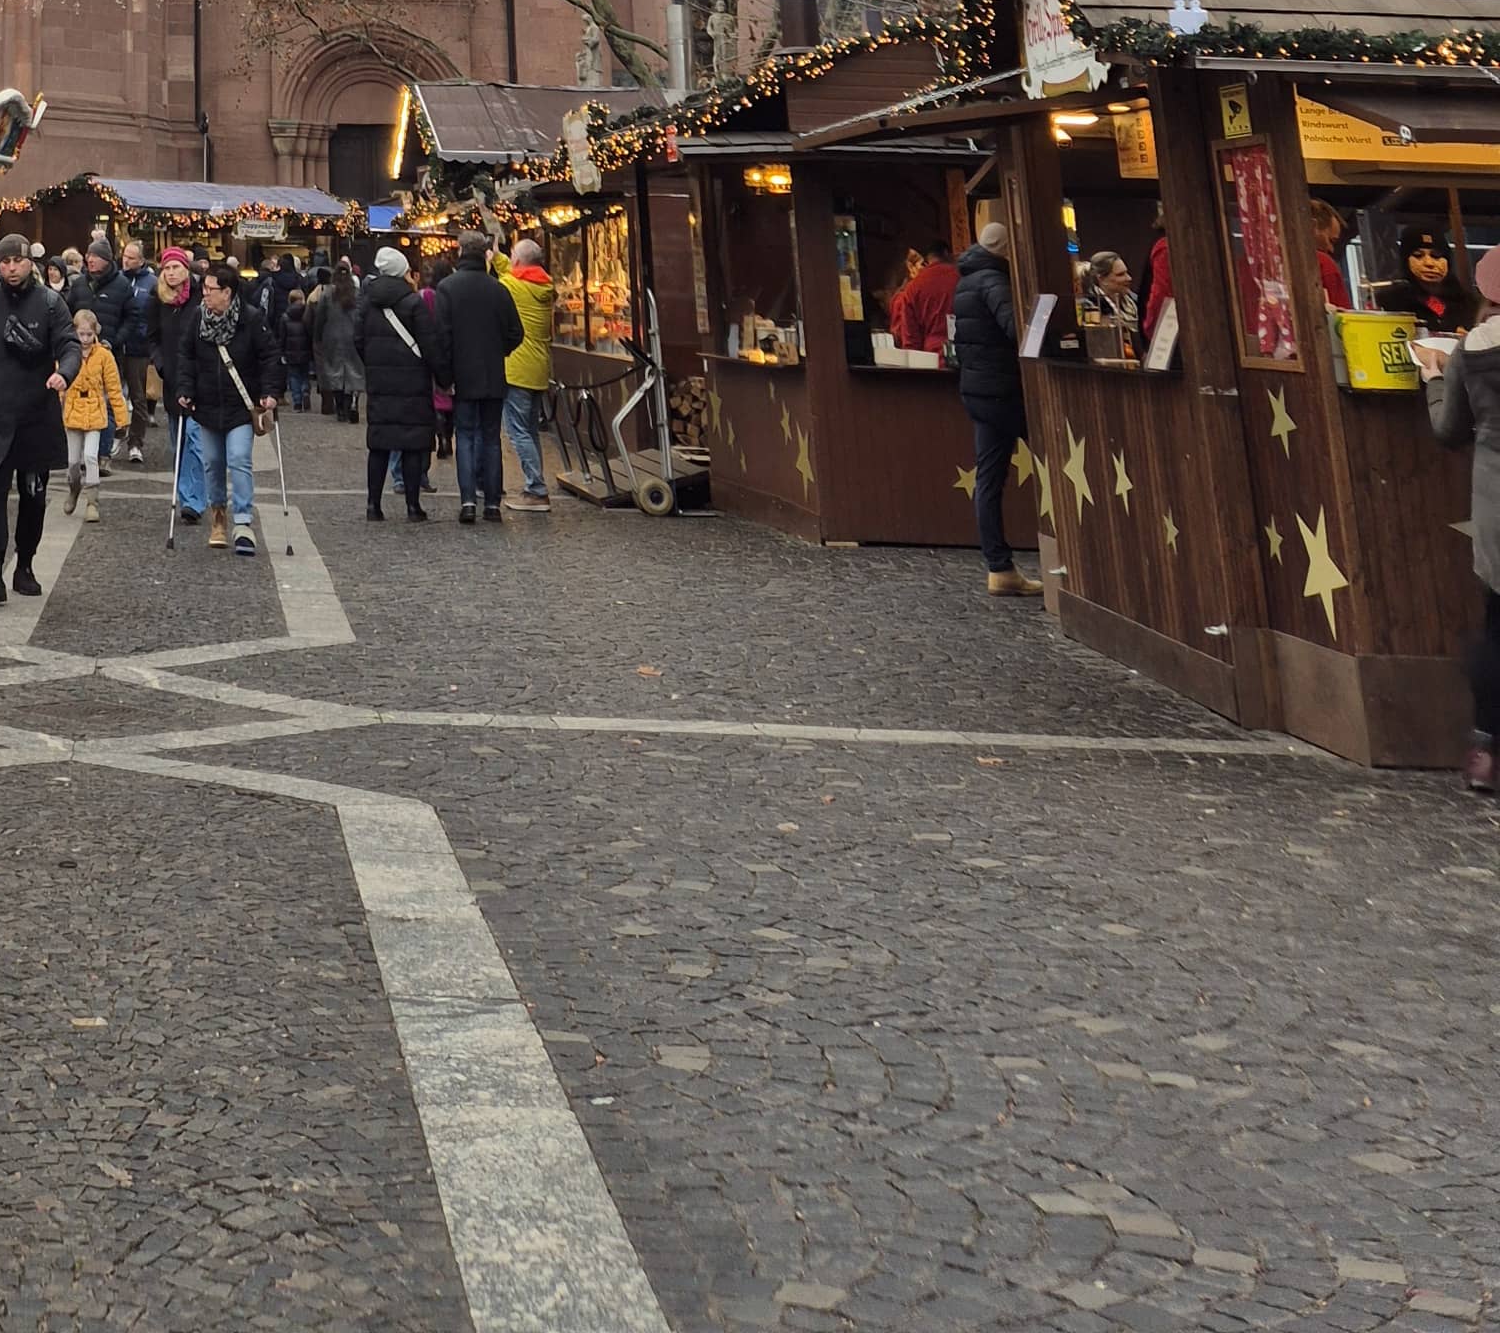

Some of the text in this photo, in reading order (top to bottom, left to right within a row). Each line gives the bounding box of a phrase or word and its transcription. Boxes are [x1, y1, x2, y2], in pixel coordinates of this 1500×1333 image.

[1300, 106, 1326, 117] Lange
[1301, 119, 1349, 131] Rindswurst
[1303, 133, 1344, 145] Polnische
[1346, 135, 1372, 146] Wurst
[1380, 343, 1411, 365] SEN
